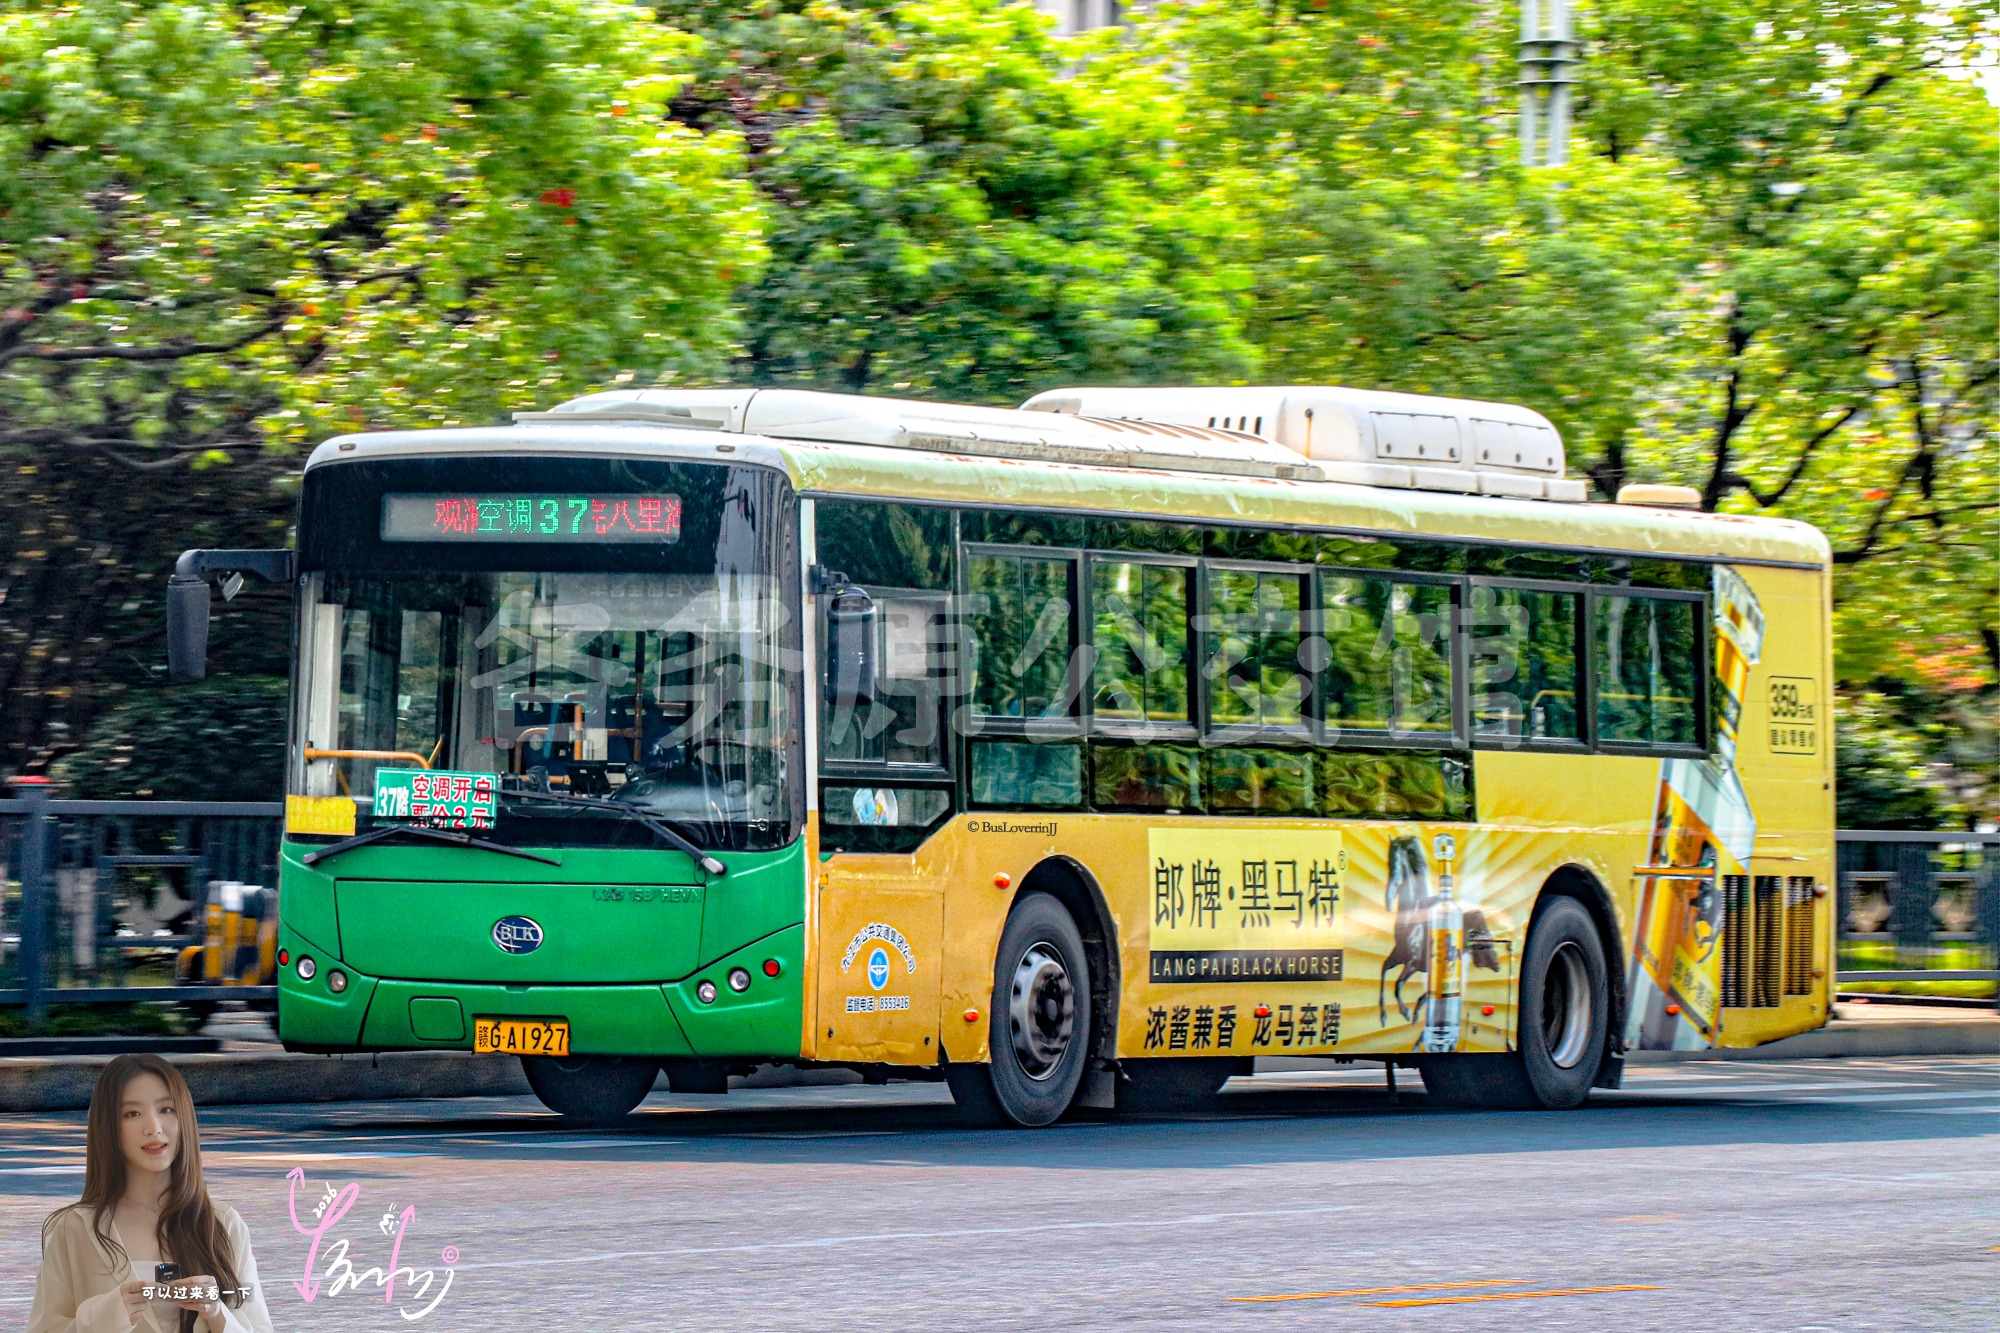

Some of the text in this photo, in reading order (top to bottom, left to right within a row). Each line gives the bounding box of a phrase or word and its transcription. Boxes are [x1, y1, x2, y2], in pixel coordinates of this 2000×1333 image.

[378, 786, 409, 817] 37路
[412, 775, 492, 803] 空调开启
[500, 926, 535, 941] BLK
[1152, 956, 1341, 977] LANG PAI BLACK HORSE
[1144, 1003, 1342, 1051] 浓酱兼香 龙马奔腾
